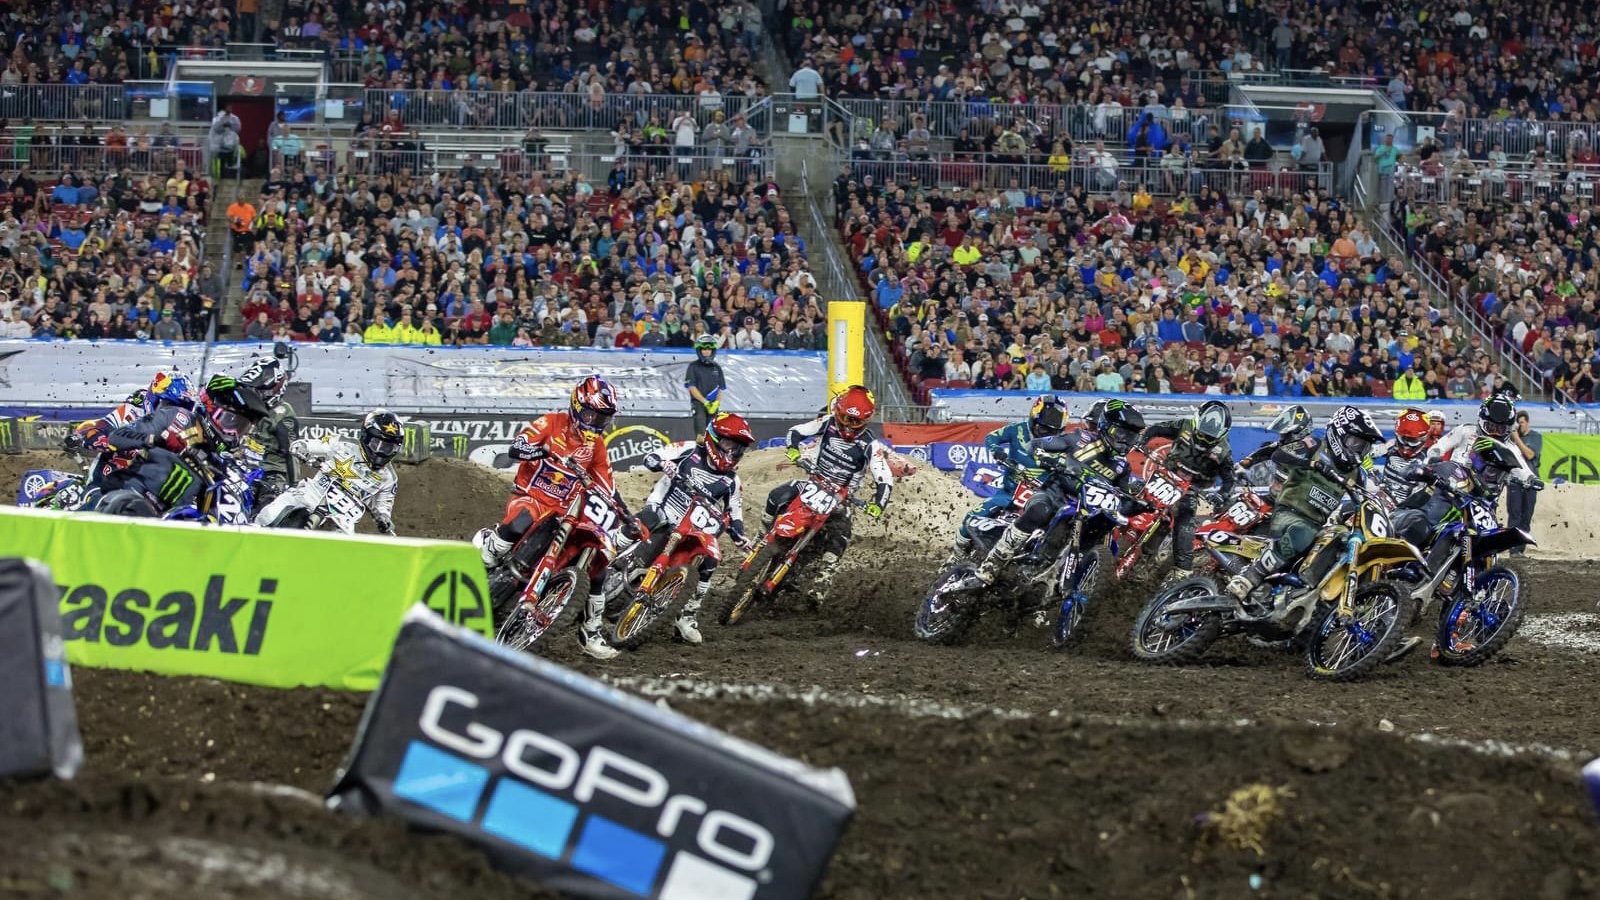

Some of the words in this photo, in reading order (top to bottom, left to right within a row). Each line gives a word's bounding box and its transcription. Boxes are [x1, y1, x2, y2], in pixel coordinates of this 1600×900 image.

[583, 495, 617, 531] 31
[1085, 485, 1120, 511] 58
[690, 505, 720, 535] 62
[1370, 512, 1388, 538] 6
[420, 685, 775, 872] GoPro
